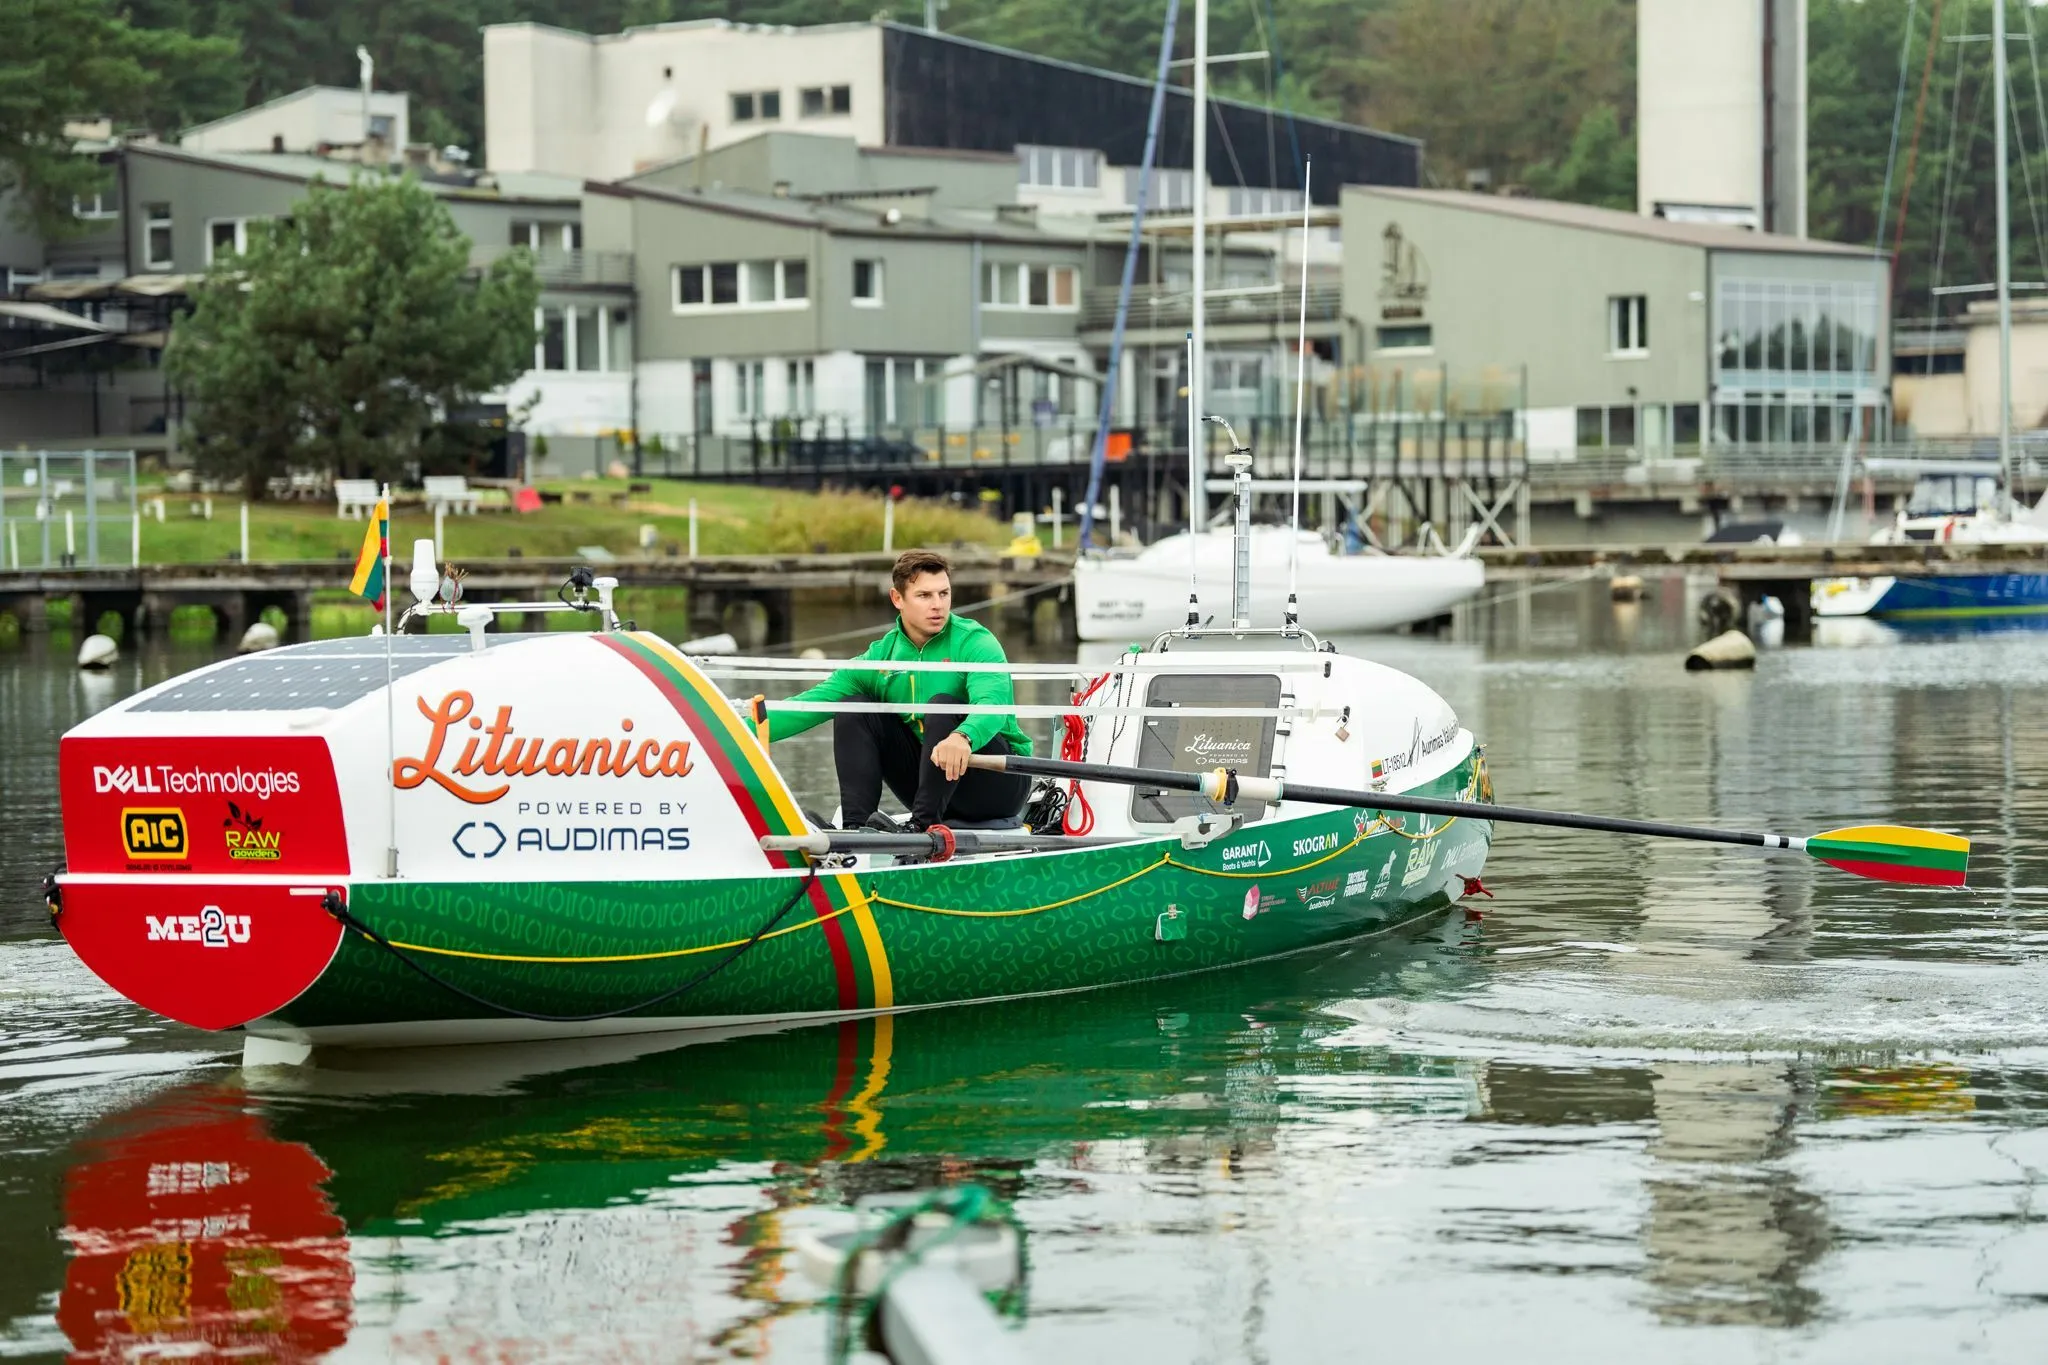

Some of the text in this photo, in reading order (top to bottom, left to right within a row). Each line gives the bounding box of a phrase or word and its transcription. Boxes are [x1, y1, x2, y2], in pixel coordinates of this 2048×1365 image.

[388, 689, 695, 805] Lituanica
[1184, 733, 1252, 755] Lituanica
[93, 764, 300, 800] DELL Technologies
[518, 802, 689, 815] POWERED BY
[130, 818, 179, 848] AIC
[225, 830, 281, 848] RAW
[517, 827, 690, 851] AUDIMAS
[1292, 831, 1339, 857] SKOGRAN
[1222, 843, 1258, 861] GARANT
[1404, 839, 1441, 873] RAW
[1222, 861, 1236, 872] Boats
[1241, 859, 1256, 869] Yachts
[145, 905, 252, 948] ME2U
